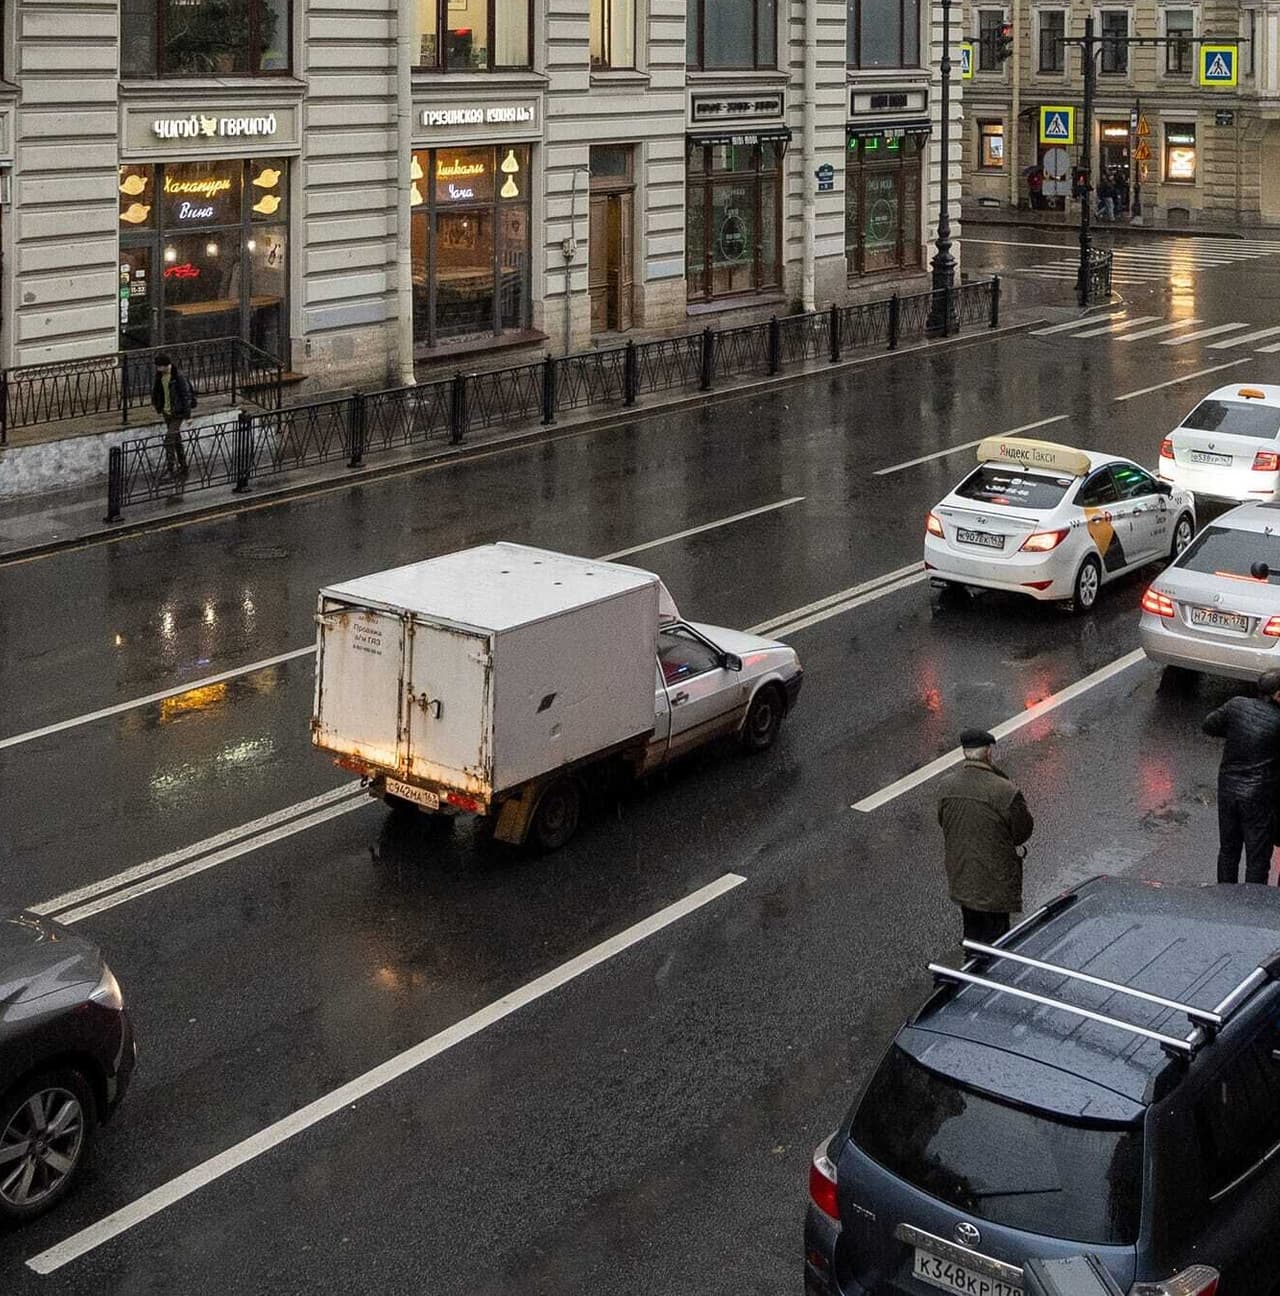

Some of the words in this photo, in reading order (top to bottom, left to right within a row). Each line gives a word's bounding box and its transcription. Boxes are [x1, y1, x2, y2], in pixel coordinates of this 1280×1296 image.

[423, 107, 483, 125] ГРУЗИНСКАЯ
[179, 201, 214, 219] Вино
[1000, 443, 1030, 460] Яндекс
[1032, 447, 1056, 463] Такси
